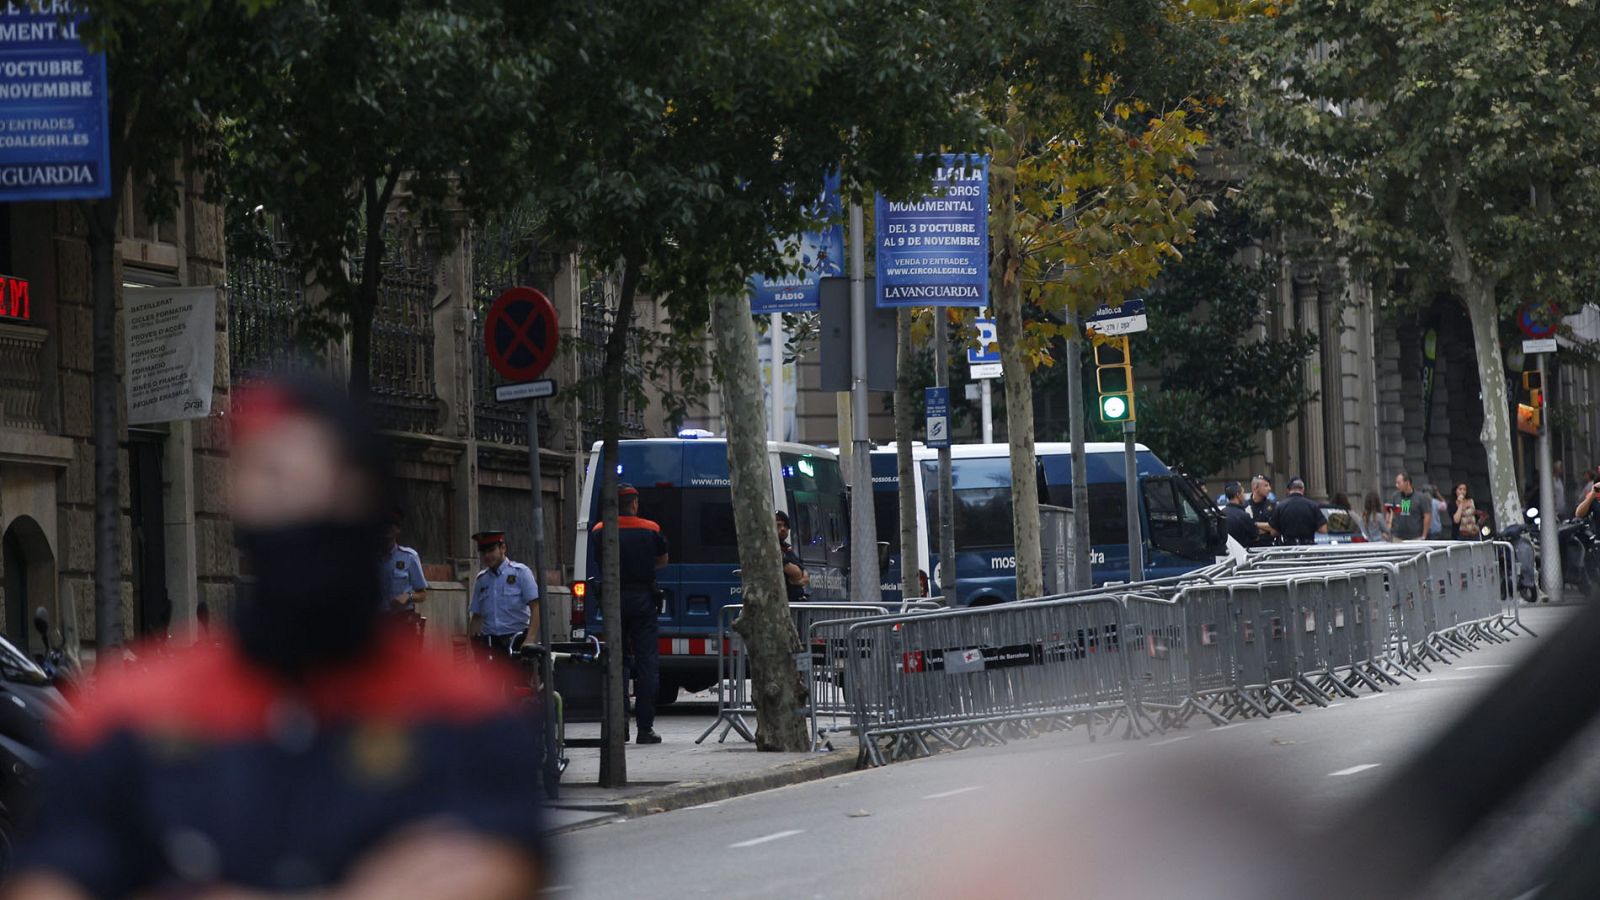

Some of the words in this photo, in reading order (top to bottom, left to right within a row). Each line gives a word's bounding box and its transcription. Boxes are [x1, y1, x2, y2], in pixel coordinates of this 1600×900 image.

[0, 60, 84, 77] 'OCTUBRE
[0, 81, 93, 99] NOVEMBRE
[0, 164, 94, 186] GUARDIA
[948, 186, 980, 196] OROS
[889, 201, 974, 212] MONUMENTAL
[889, 224, 907, 234] DEL
[909, 224, 917, 233] 3
[919, 223, 976, 233] D'OCTUBRE
[883, 238, 896, 247] AL
[898, 237, 905, 246] 9
[908, 237, 922, 246] DE
[924, 236, 981, 247] NOVEMBRE
[895, 258, 921, 266] VENDA
[886, 267, 978, 276] WWW.CIRCOALEGRIA.ES
[885, 287, 900, 298] LA
[901, 286, 980, 298] VANGUARDIA
